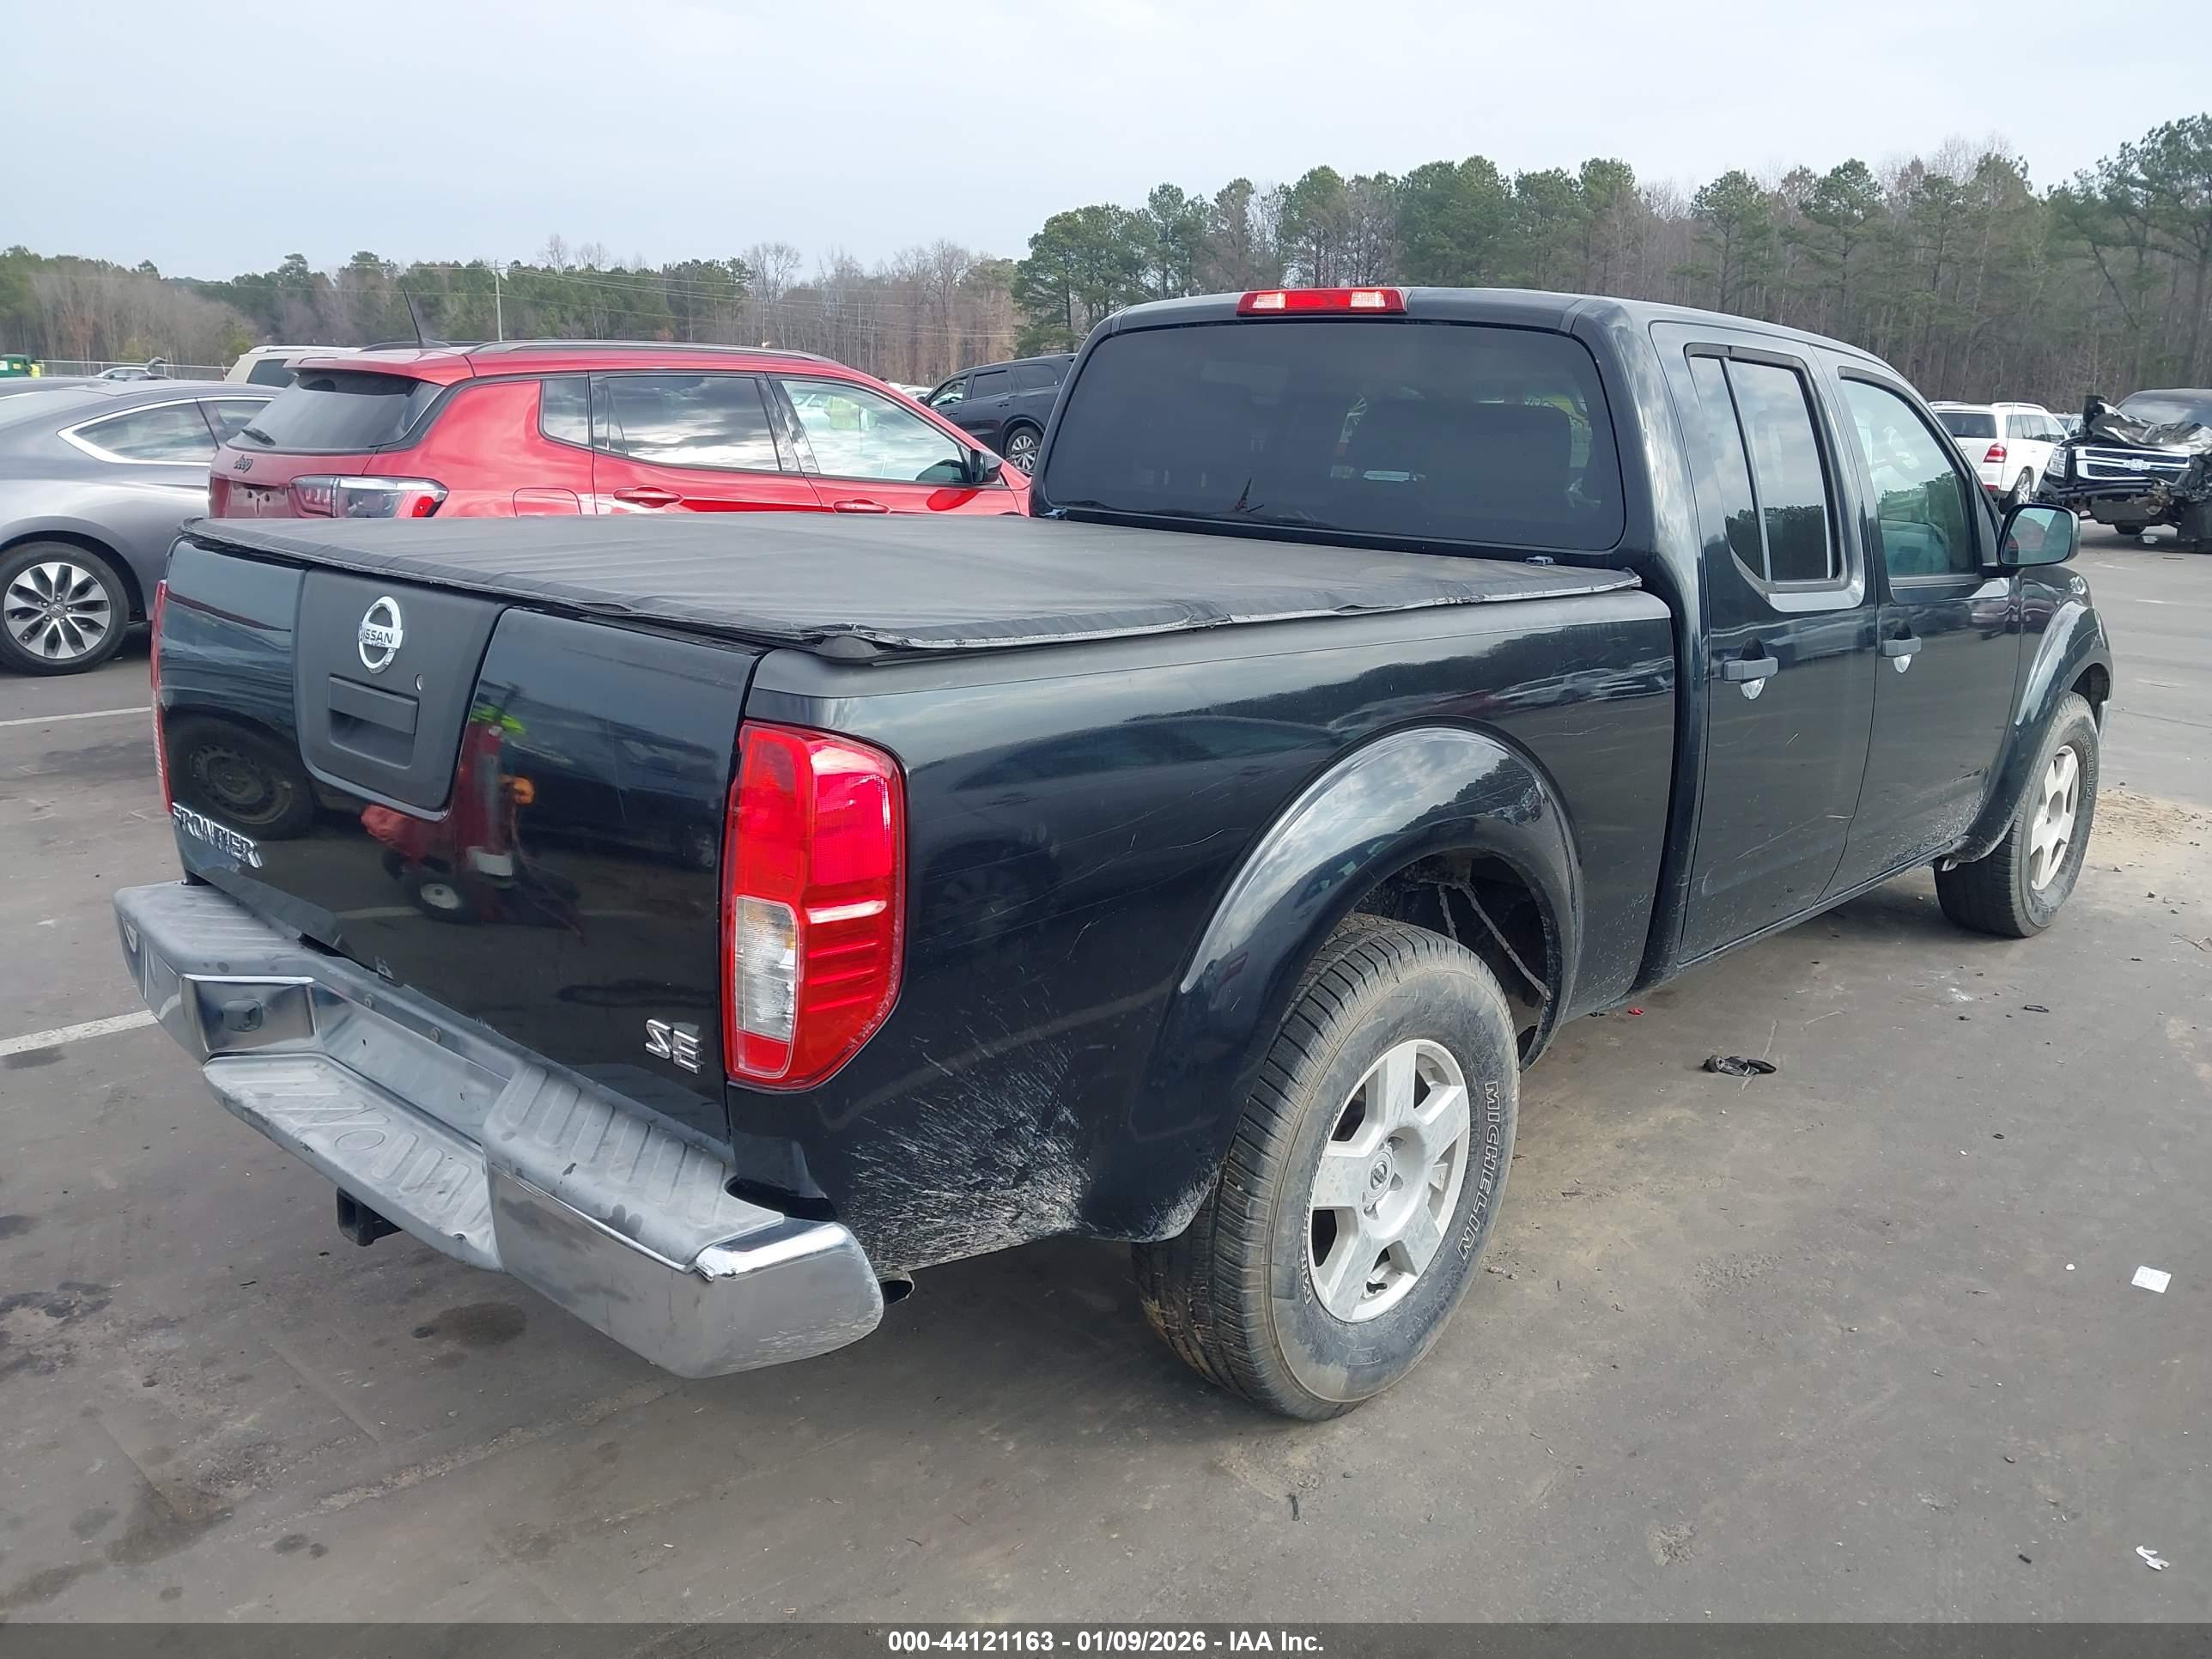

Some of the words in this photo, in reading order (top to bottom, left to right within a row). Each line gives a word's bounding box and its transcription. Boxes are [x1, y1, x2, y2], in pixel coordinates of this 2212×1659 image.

[171, 802, 263, 868] FRONTIER
[645, 1019, 702, 1074] SE
[1457, 1080, 1501, 1260] MICHELIN
